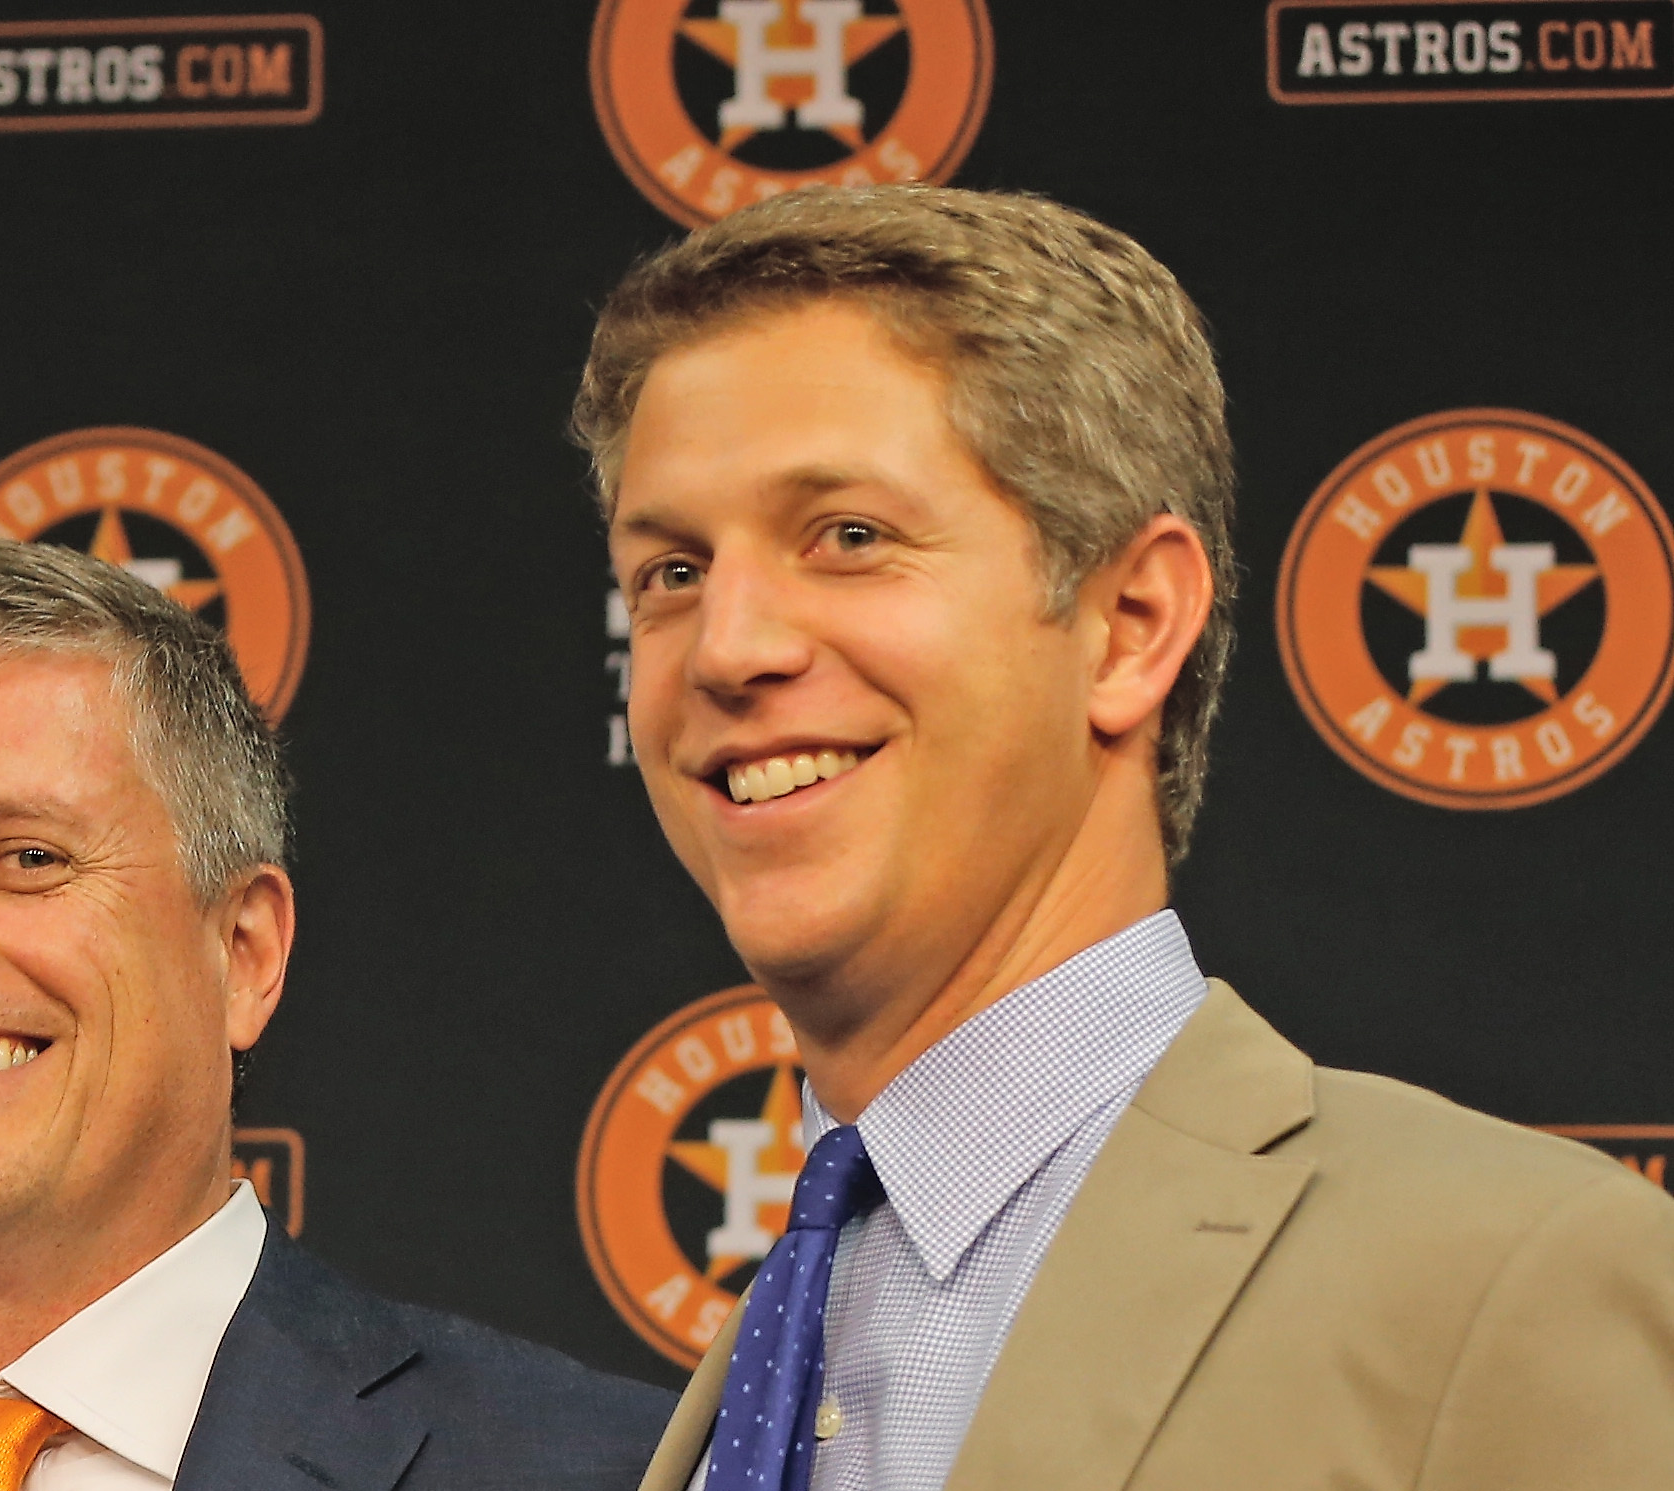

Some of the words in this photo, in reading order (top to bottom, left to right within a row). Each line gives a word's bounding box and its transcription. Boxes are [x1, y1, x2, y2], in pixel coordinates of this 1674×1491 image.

[716, 0, 866, 131] H
[1296, 20, 1656, 77] ASTROS.COM
[1334, 434, 1632, 541] HOUSTON
[1407, 542, 1557, 682] H
[1347, 692, 1616, 773] ASTROS
[636, 1010, 799, 1115] HOUS
